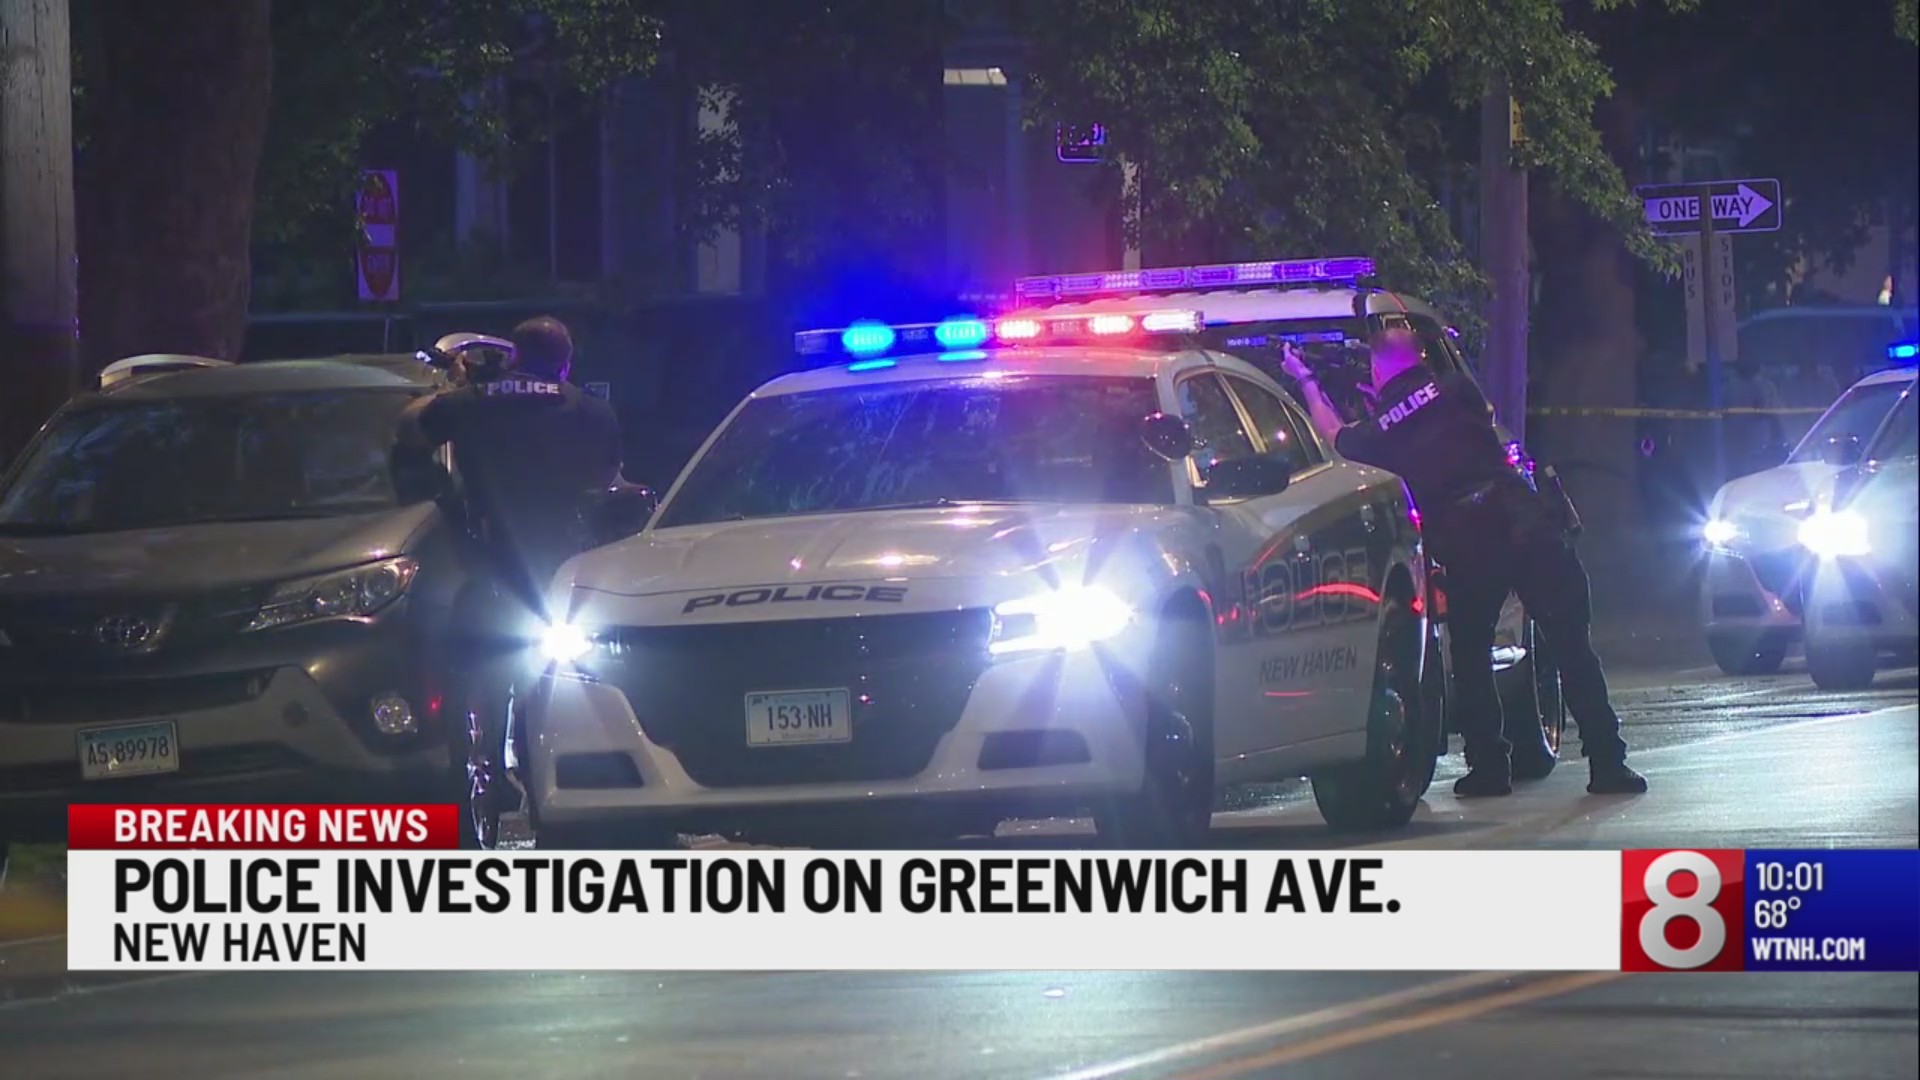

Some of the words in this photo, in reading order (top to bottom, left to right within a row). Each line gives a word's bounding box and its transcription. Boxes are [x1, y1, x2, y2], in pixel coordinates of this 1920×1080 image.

[1659, 199, 1700, 219] ONE
[1713, 197, 1753, 216] WAY
[1685, 249, 1696, 299] BUS
[1720, 236, 1732, 305] STOP
[487, 380, 559, 395] POLICE
[1378, 382, 1439, 431] POLICE
[682, 585, 908, 614] POLICE
[1243, 548, 1370, 636] POLICE
[1259, 654, 1300, 683] NEW
[1302, 645, 1357, 678] HAVEN
